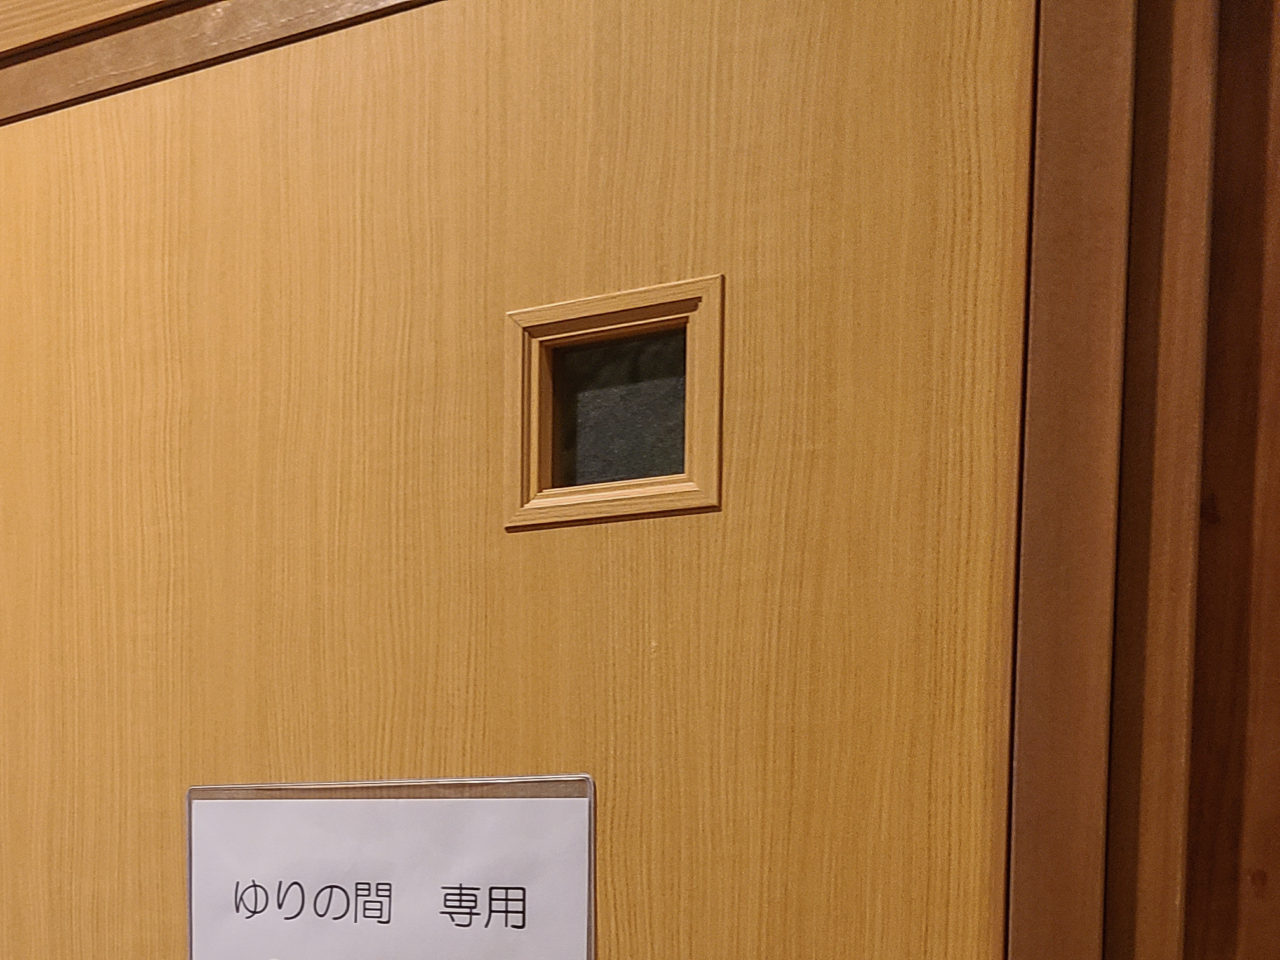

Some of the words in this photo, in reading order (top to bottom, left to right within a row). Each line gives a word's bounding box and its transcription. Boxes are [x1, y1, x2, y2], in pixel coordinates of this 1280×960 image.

[234, 880, 392, 924] ゆりの間
[439, 883, 526, 930] 専用
